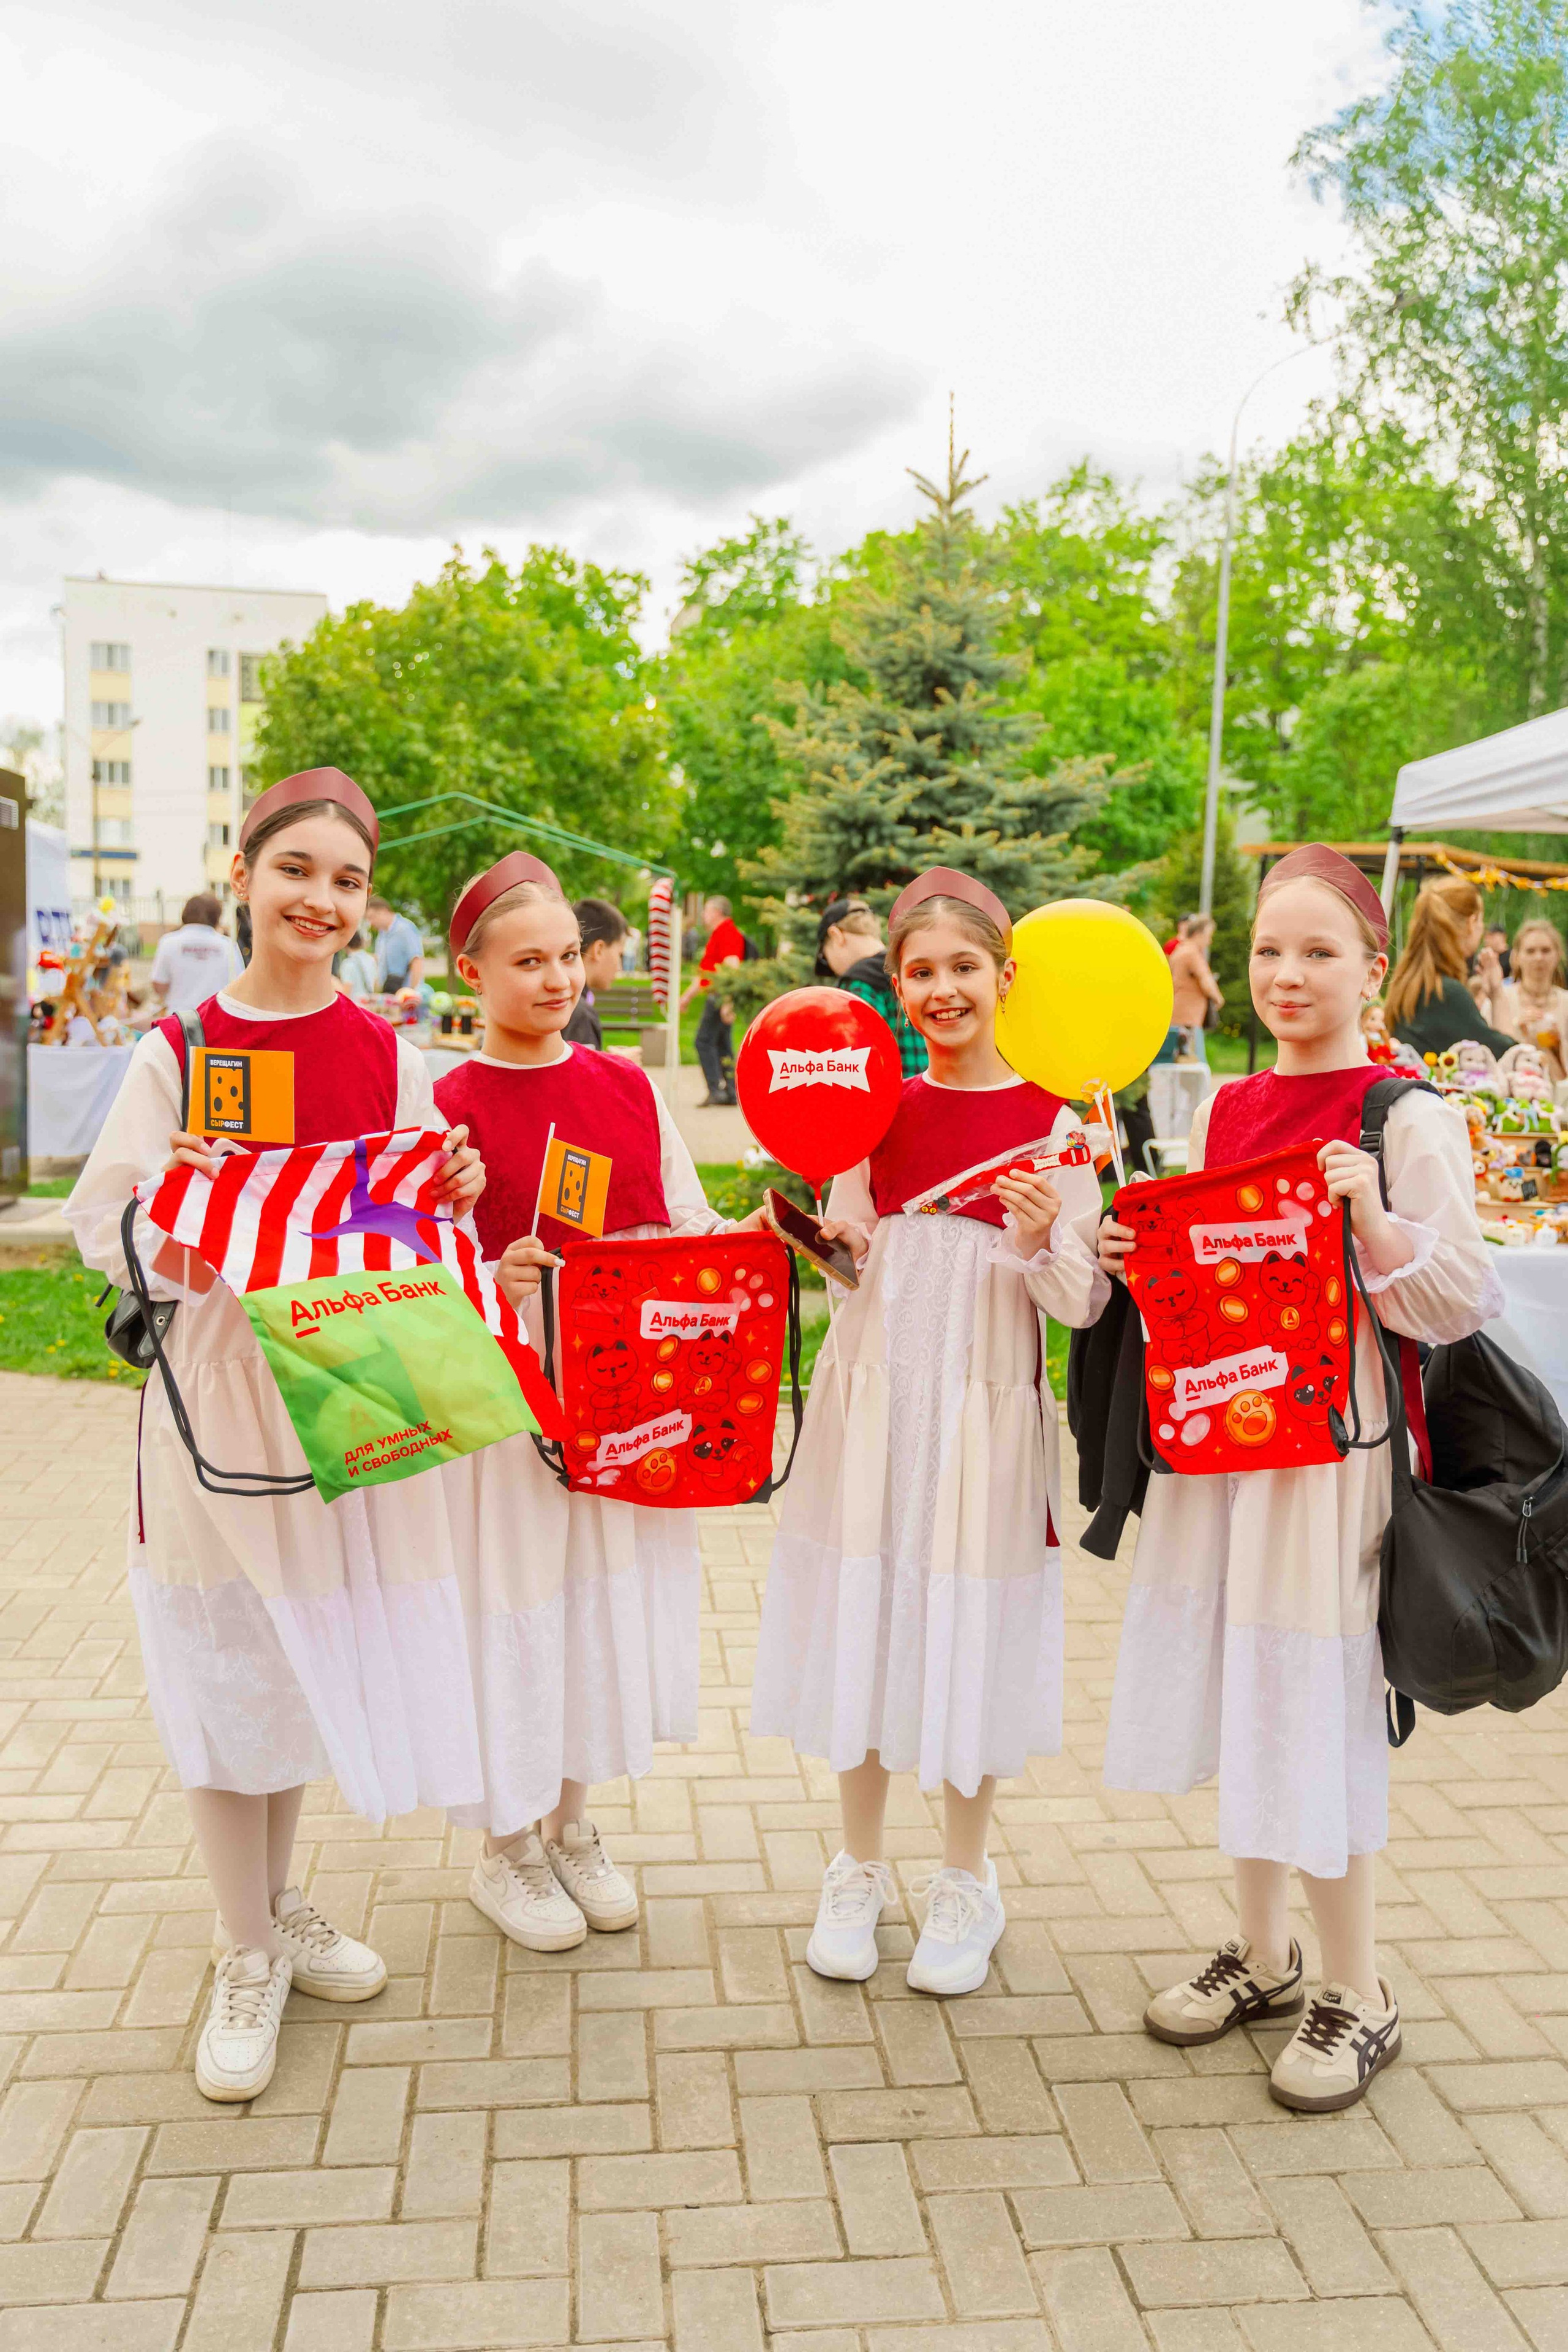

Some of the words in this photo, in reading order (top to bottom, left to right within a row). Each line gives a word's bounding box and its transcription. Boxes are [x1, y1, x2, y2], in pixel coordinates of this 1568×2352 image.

[780, 1060, 824, 1079] Альфа
[827, 1060, 859, 1072] Банк
[211, 1119, 244, 1129] СЫРФЕСТ
[1203, 1234, 1253, 1255] Альфа
[1254, 1233, 1297, 1247] Банк
[290, 1290, 382, 1338] Альфа
[377, 1281, 447, 1302] Банк
[649, 1311, 698, 1332] Альфа
[700, 1314, 731, 1327] Банк
[1185, 1371, 1238, 1401] Альфа
[1239, 1359, 1278, 1380] Банк
[344, 1442, 375, 1465] ДЛЯ
[377, 1420, 432, 1449] УМНЫХ
[347, 1466, 360, 1478] И
[362, 1428, 453, 1471] СВОБОДНЫХ
[605, 1433, 650, 1460] Альфа
[652, 1420, 684, 1439] Банк
